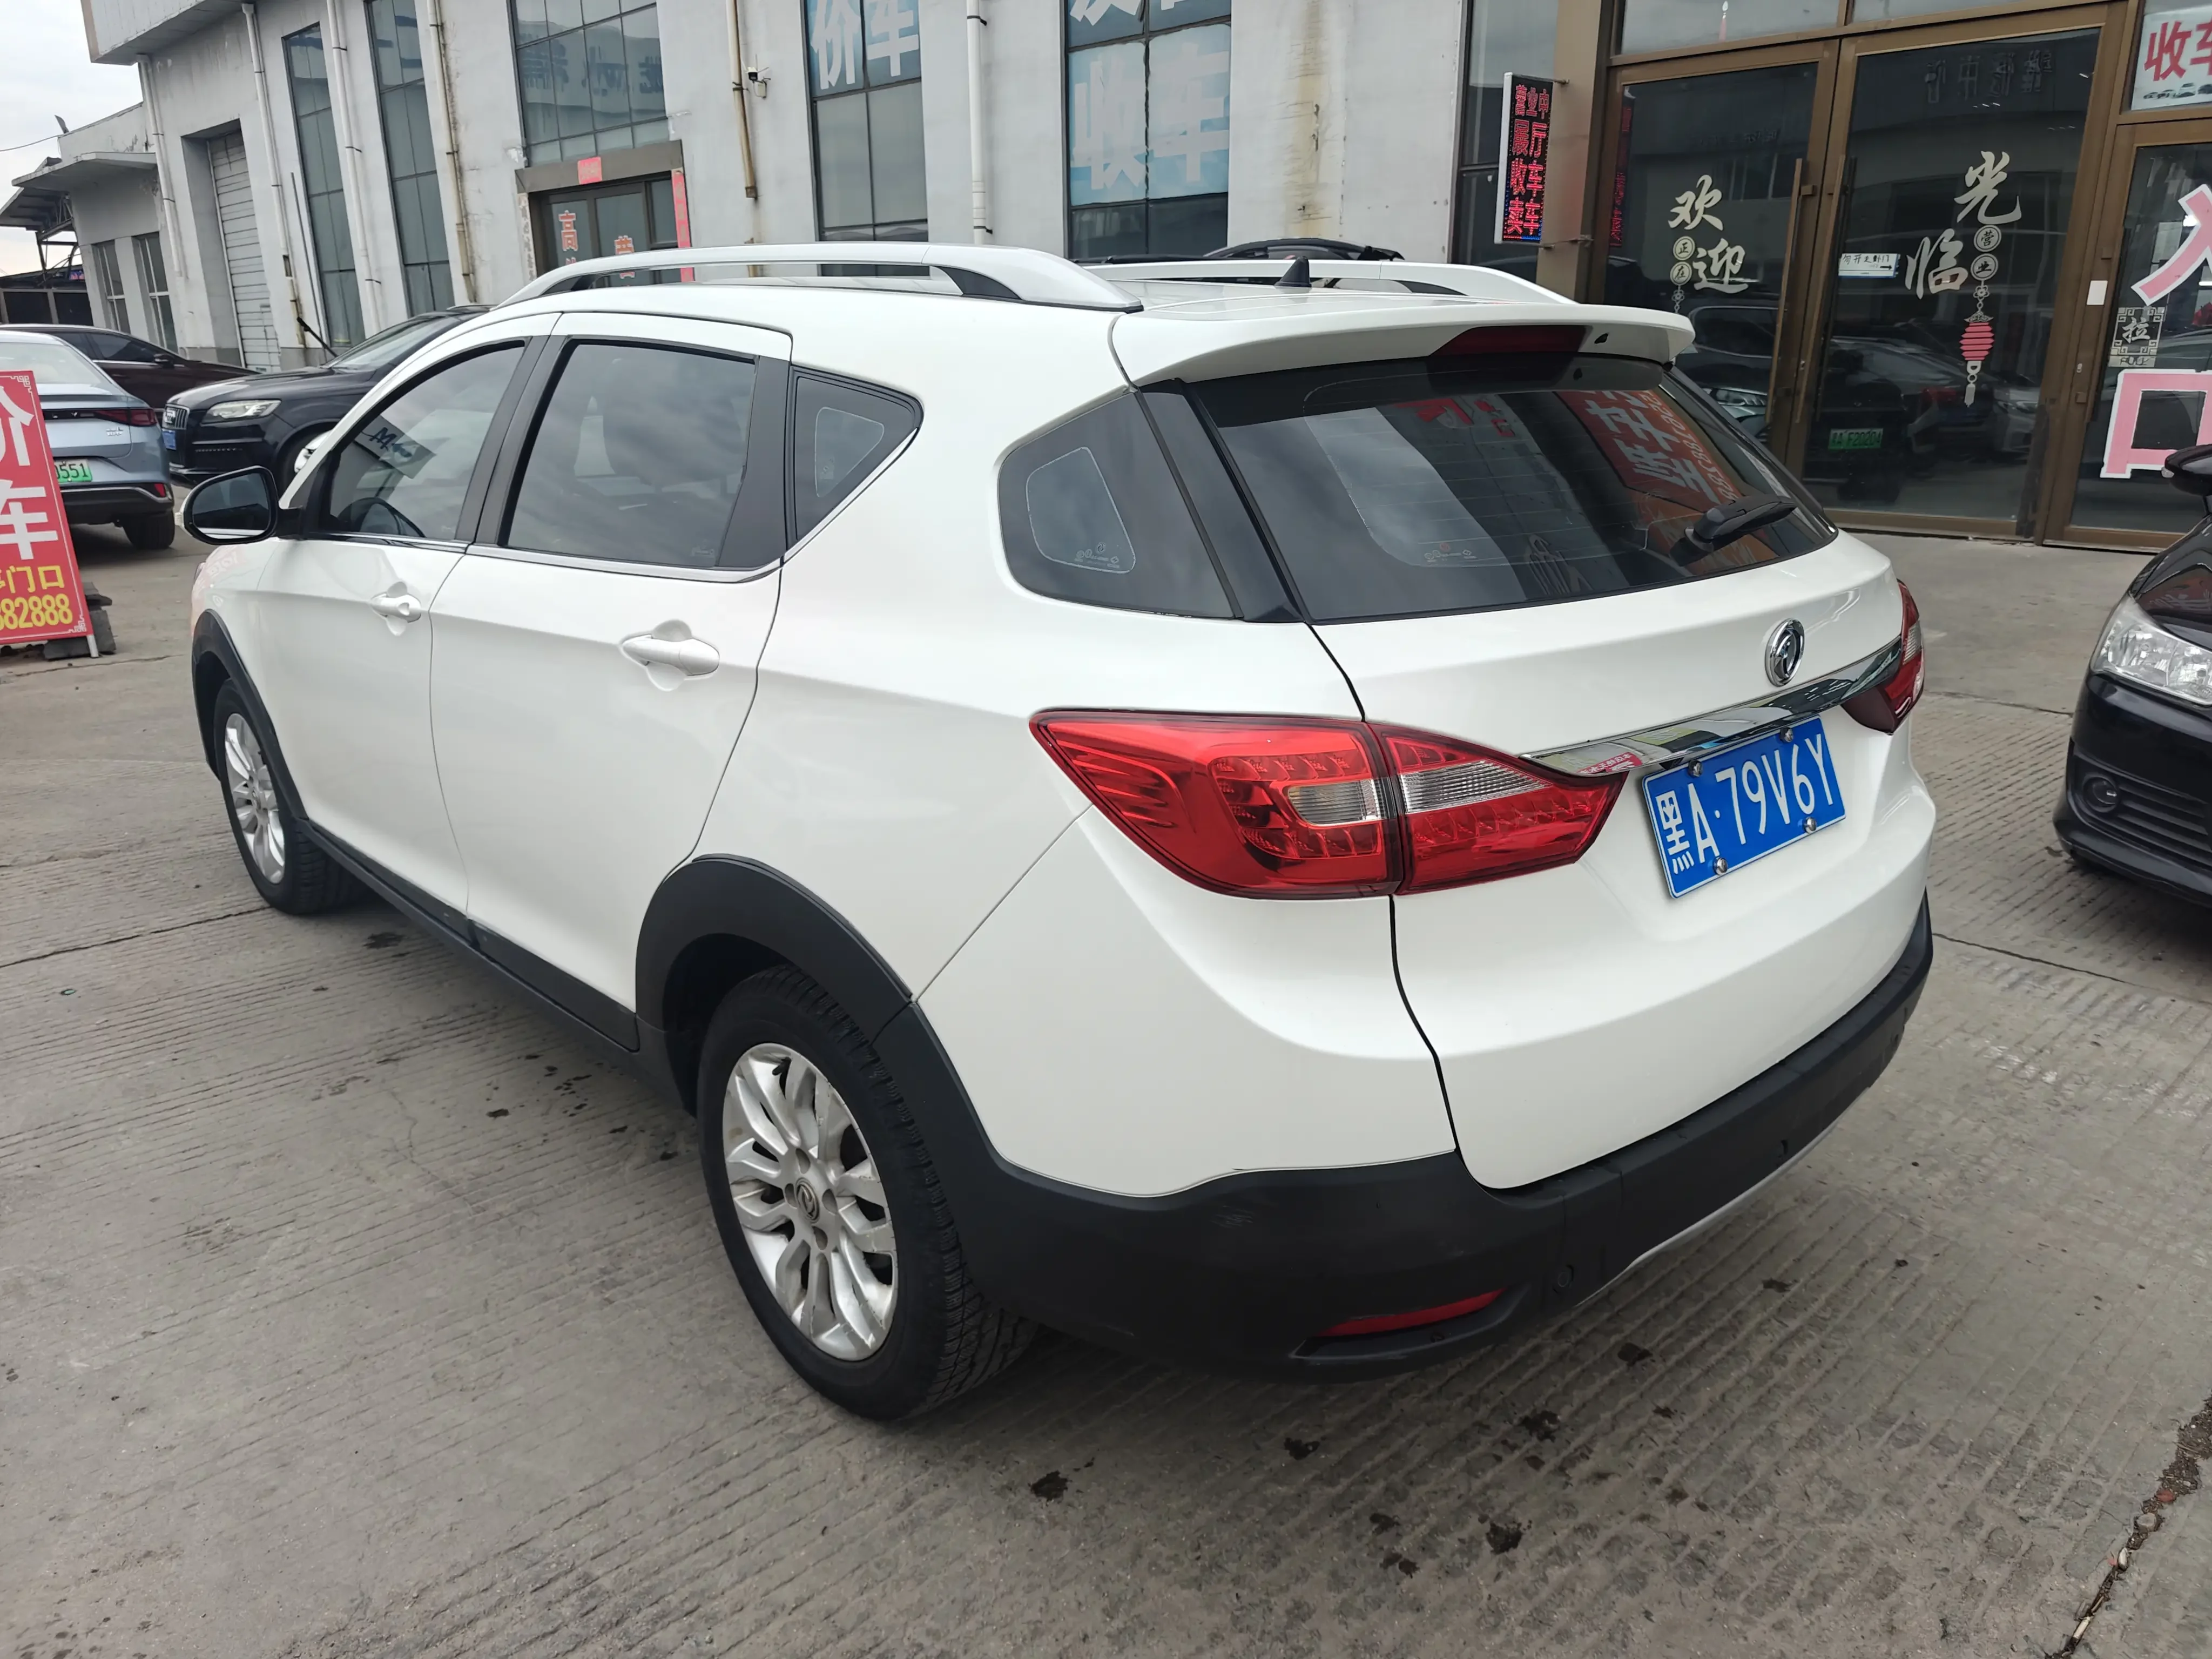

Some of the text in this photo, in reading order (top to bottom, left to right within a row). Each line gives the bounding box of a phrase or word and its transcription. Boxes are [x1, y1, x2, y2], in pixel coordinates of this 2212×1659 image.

[1512, 118, 1547, 158] 展厅
[1510, 157, 1545, 197] 收车
[1507, 196, 1541, 235] 卖车
[1668, 174, 1749, 294] 欢迎
[2122, 316, 2151, 344] 拉
[0, 565, 65, 594] 门口
